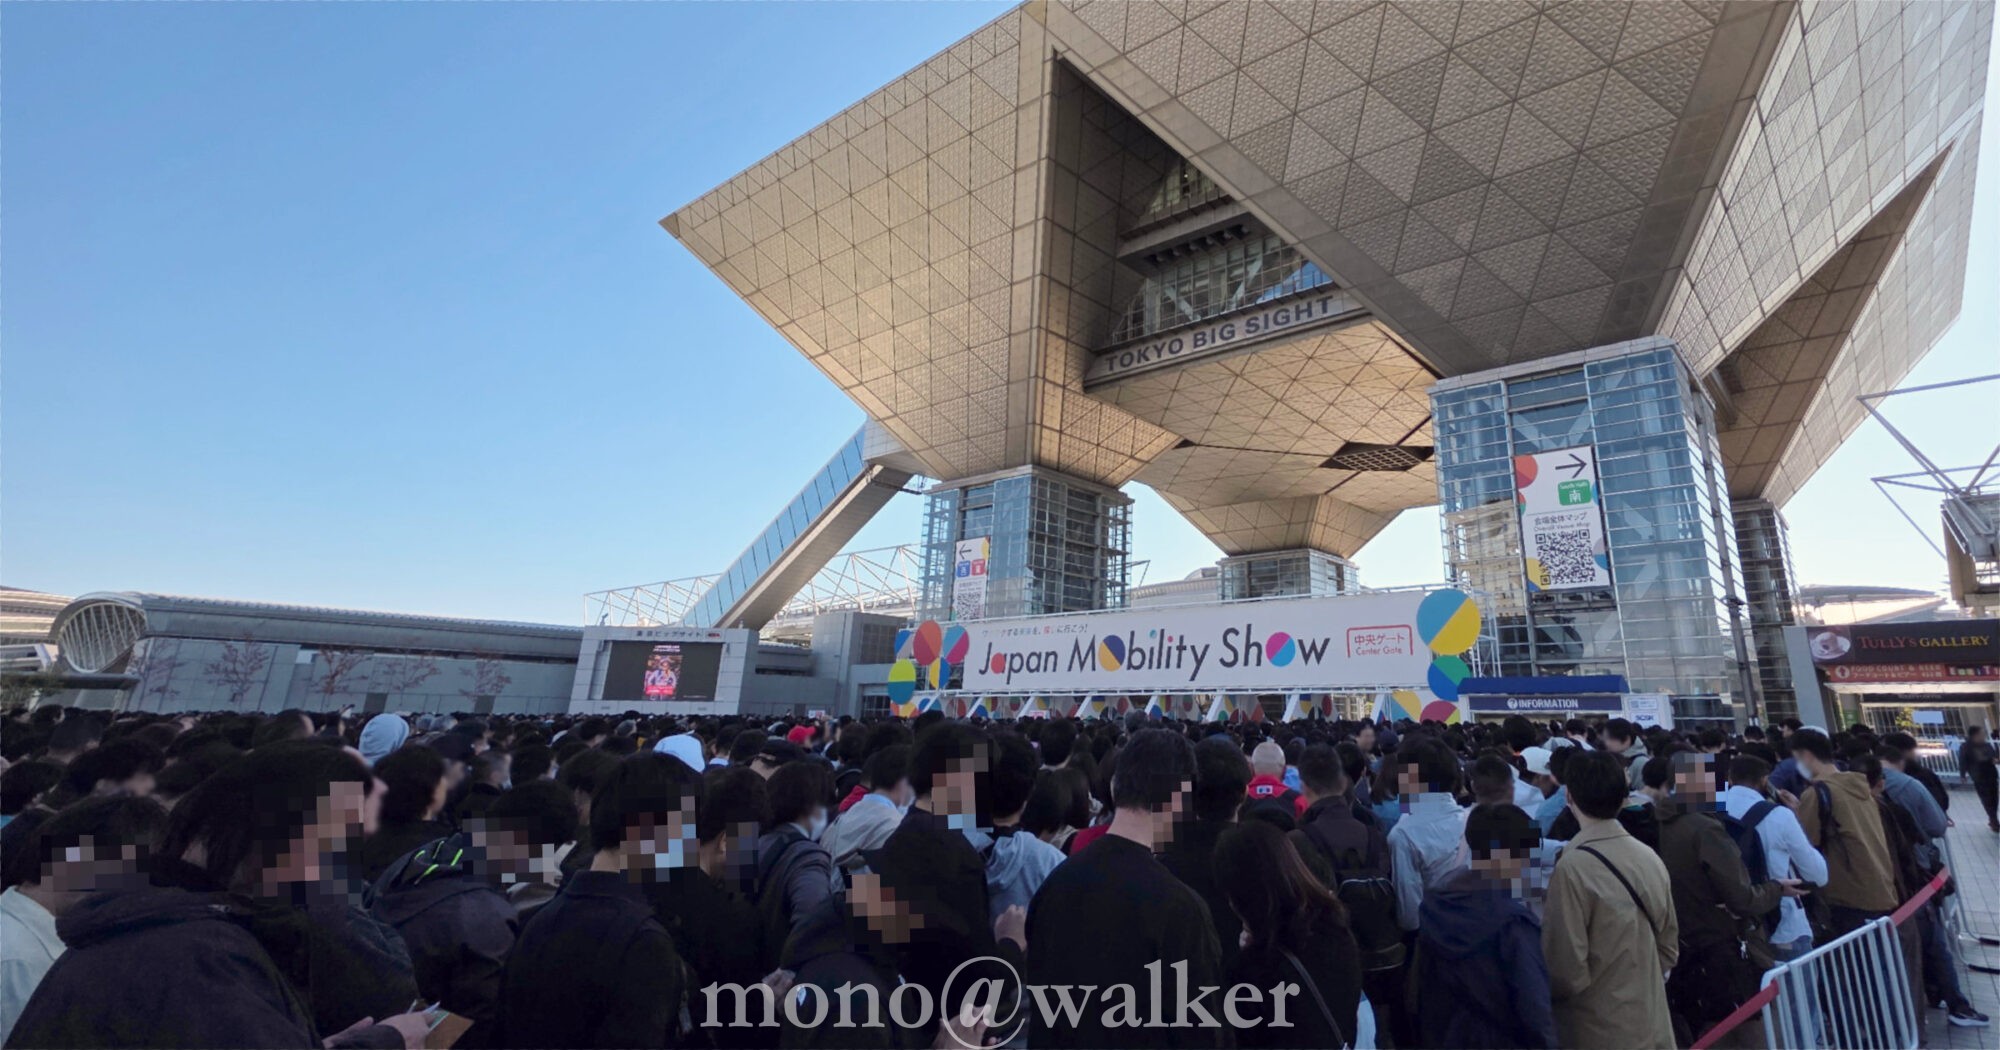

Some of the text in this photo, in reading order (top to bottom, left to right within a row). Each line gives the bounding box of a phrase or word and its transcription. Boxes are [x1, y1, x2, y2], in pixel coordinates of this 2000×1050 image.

[1105, 296, 1333, 371] TOKYO BIG SIGHT
[1569, 489, 1582, 503] 南
[1354, 632, 1405, 646] 中央ゲート
[1919, 635, 1990, 648] GALLERY
[979, 624, 1330, 684] Japan Mobility Show
[1355, 645, 1403, 656] Center Gate
[1876, 664, 1905, 672] COURT
[1518, 698, 1579, 709] INFORMATION
